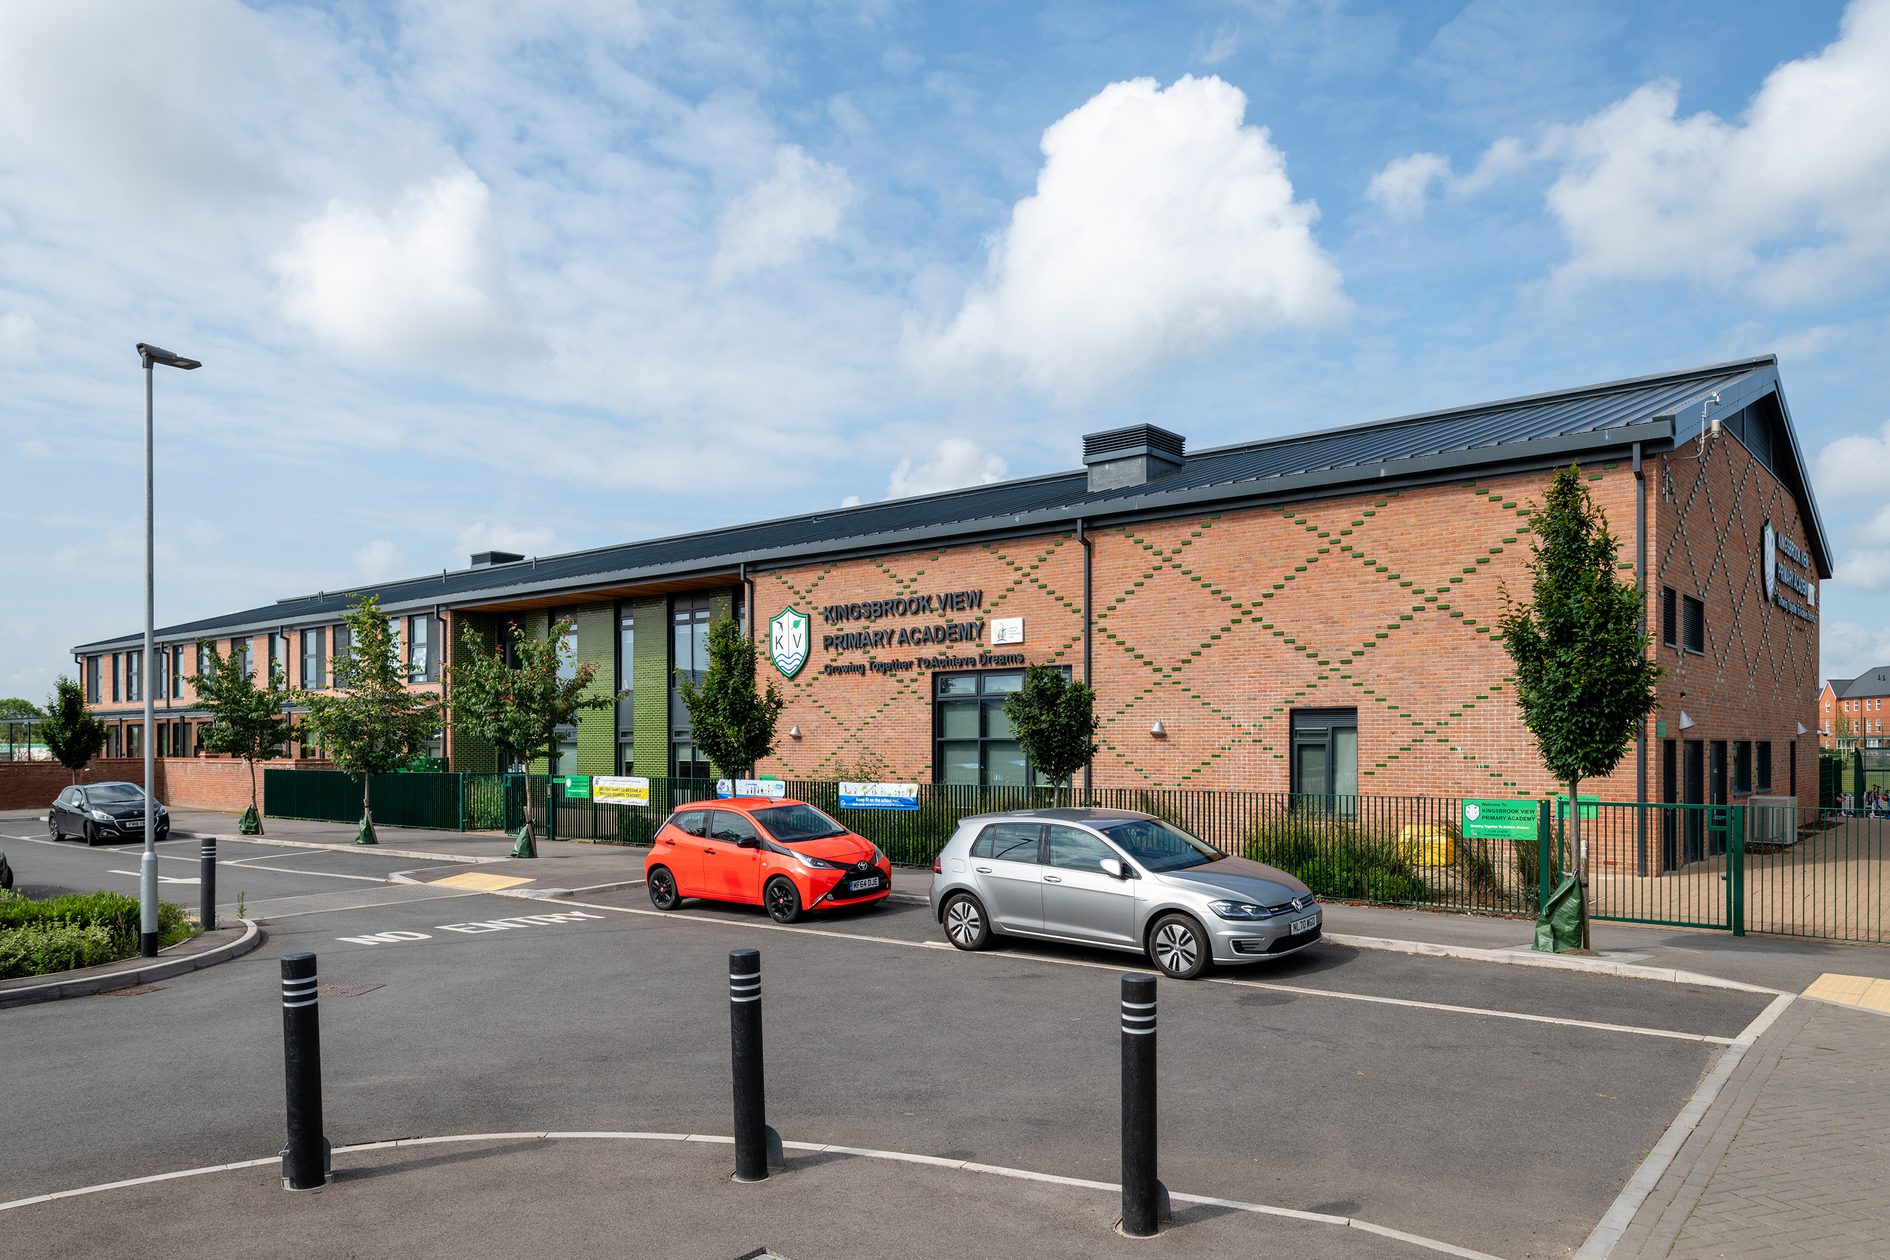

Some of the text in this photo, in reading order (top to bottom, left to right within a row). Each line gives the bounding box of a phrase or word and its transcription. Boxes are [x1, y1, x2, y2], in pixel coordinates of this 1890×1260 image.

[823, 590, 982, 622] KINGSBROOK VIEW
[775, 633, 802, 650] K V
[823, 629, 894, 651] PRIMARY
[897, 621, 984, 645] ACADEMY
[824, 652, 1025, 676] Growing Together To Achieve Dreams
[335, 911, 606, 946] NO ENTRY
